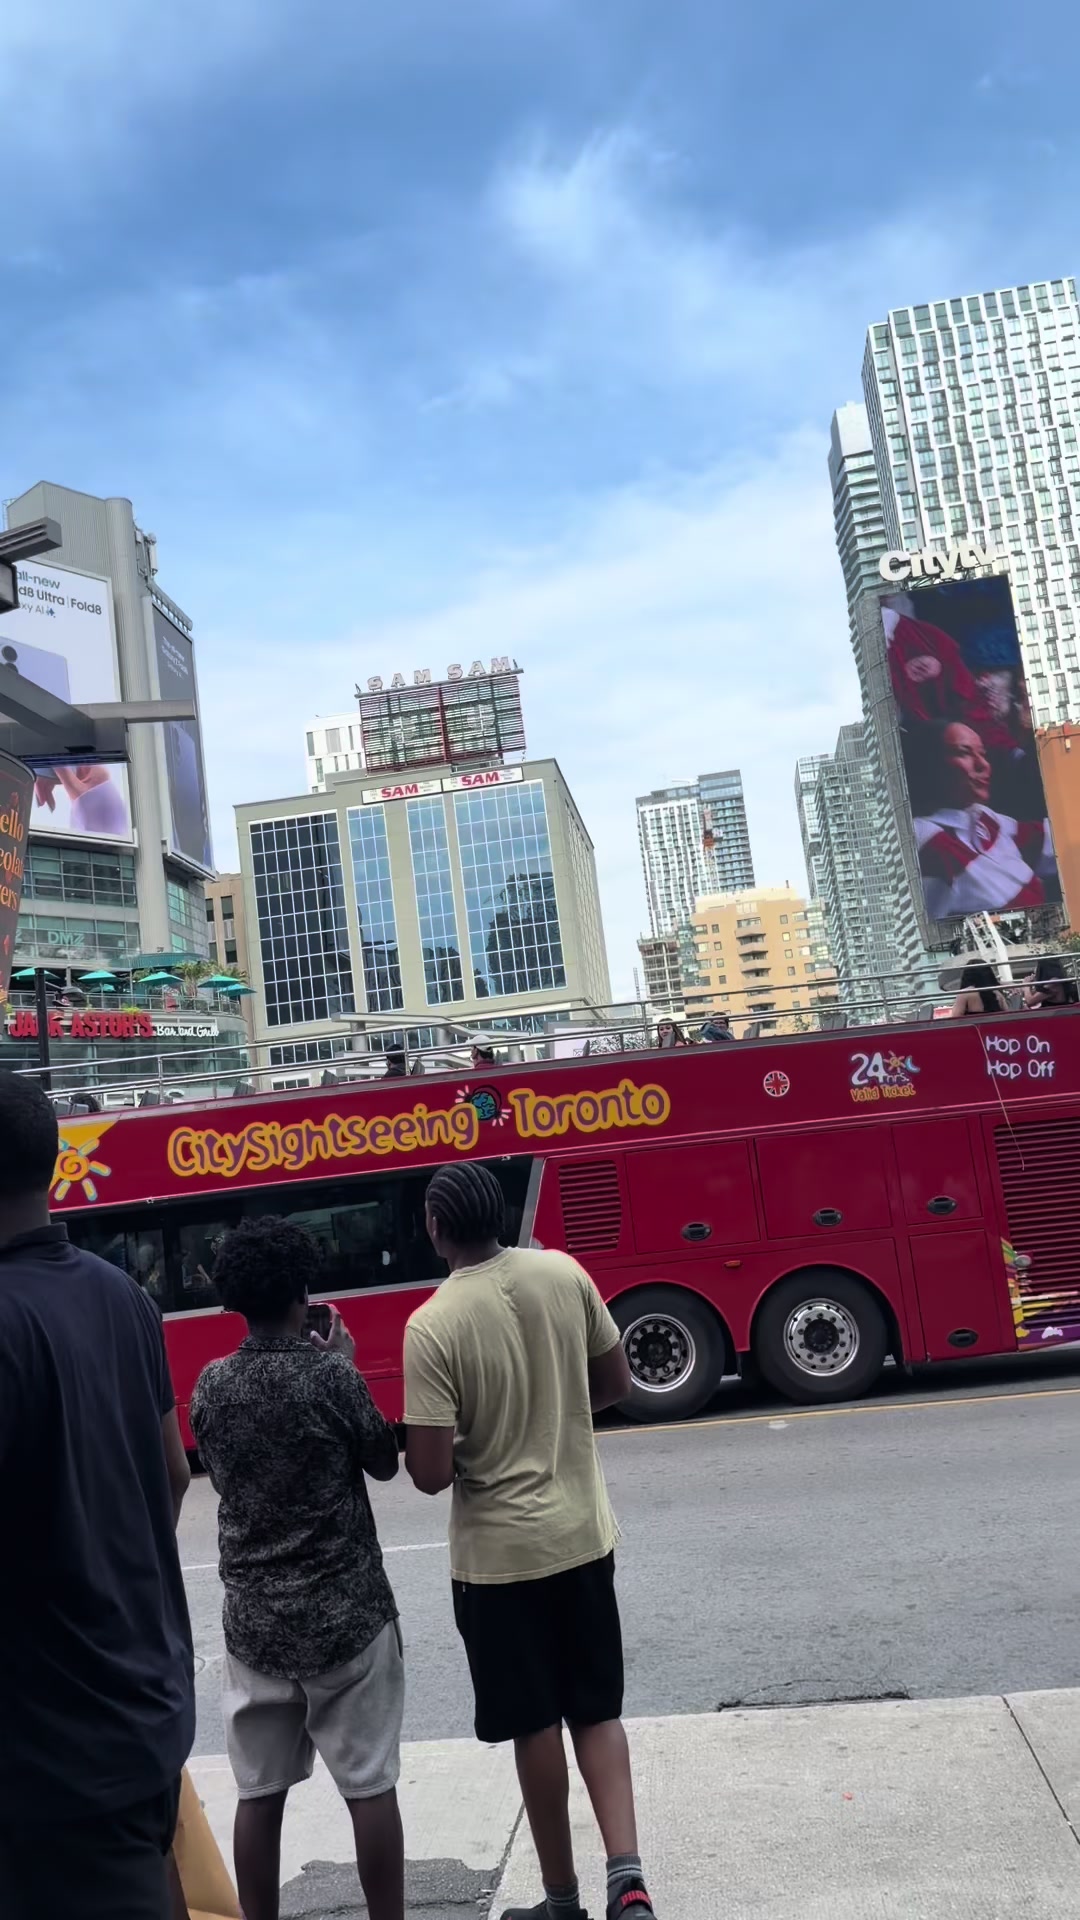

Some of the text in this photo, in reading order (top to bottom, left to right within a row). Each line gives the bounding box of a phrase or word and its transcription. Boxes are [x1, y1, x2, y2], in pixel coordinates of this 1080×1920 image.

[879, 541, 998, 582] Citytv
[18, 586, 103, 615] d8 Ultra Fold8
[366, 655, 512, 692] SAM SAM
[380, 783, 420, 799] SAM
[460, 771, 501, 787] SAM
[0, 808, 24, 842] ello
[0, 884, 18, 911] ers
[47, 930, 85, 948] DMZ
[10, 1010, 64, 1038] JAK
[156, 1025, 176, 1037] Bar
[178, 1025, 196, 1037] and
[985, 1035, 1050, 1056] Hop On
[851, 1052, 886, 1085] 24
[986, 1059, 1056, 1080] Hop Off
[850, 1082, 917, 1102] Valid Ticket
[167, 1078, 671, 1178] CitySightseeing Toronto
